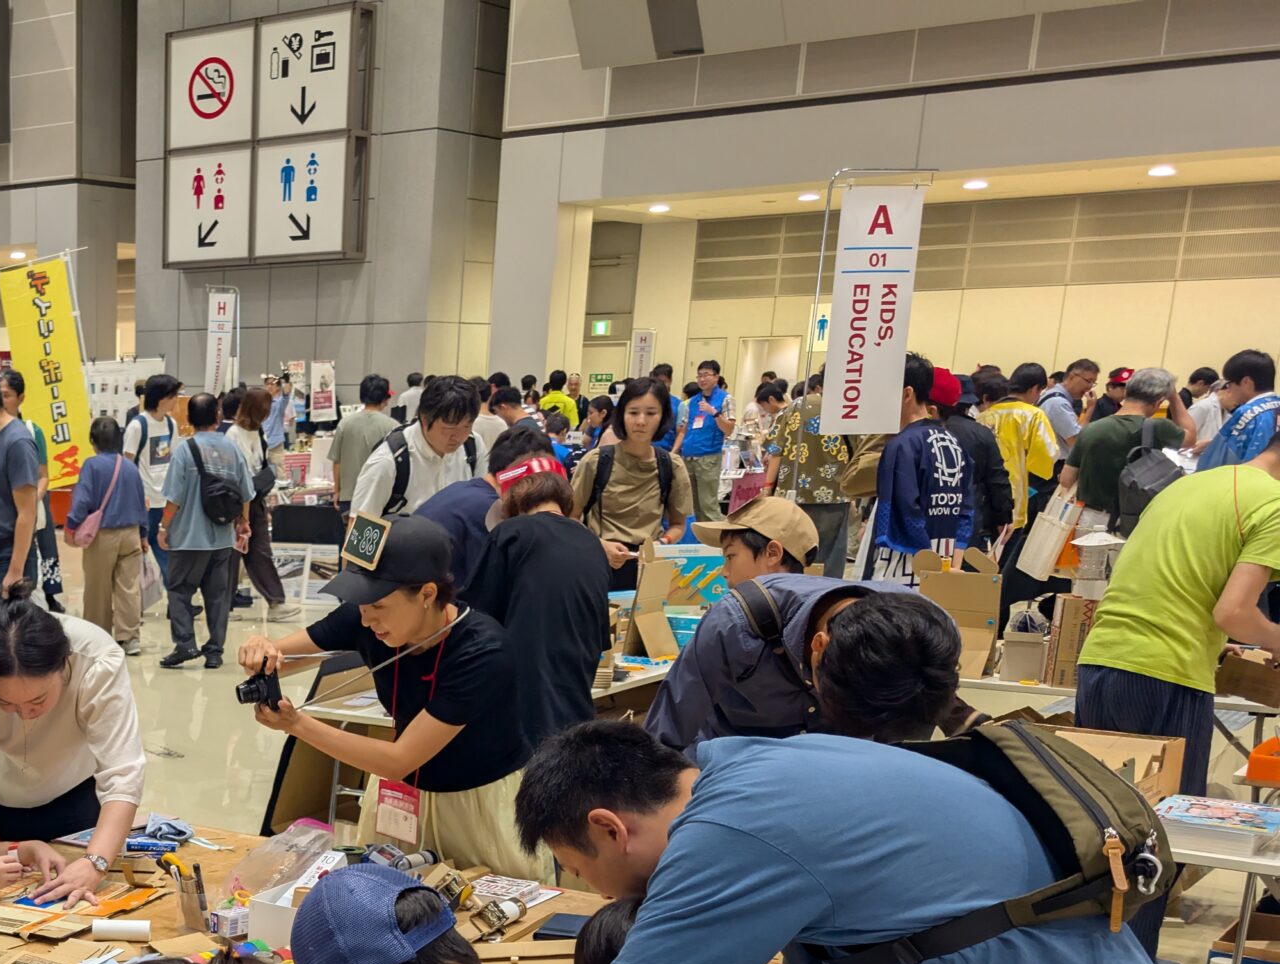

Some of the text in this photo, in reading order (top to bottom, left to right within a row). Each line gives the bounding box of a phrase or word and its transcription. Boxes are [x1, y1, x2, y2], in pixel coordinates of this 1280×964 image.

[868, 205, 893, 235] A
[869, 253, 887, 267] 01
[217, 301, 226, 315] H
[874, 283, 898, 347] KIDS,
[640, 336, 647, 344] H
[841, 284, 871, 419] EDUCATION
